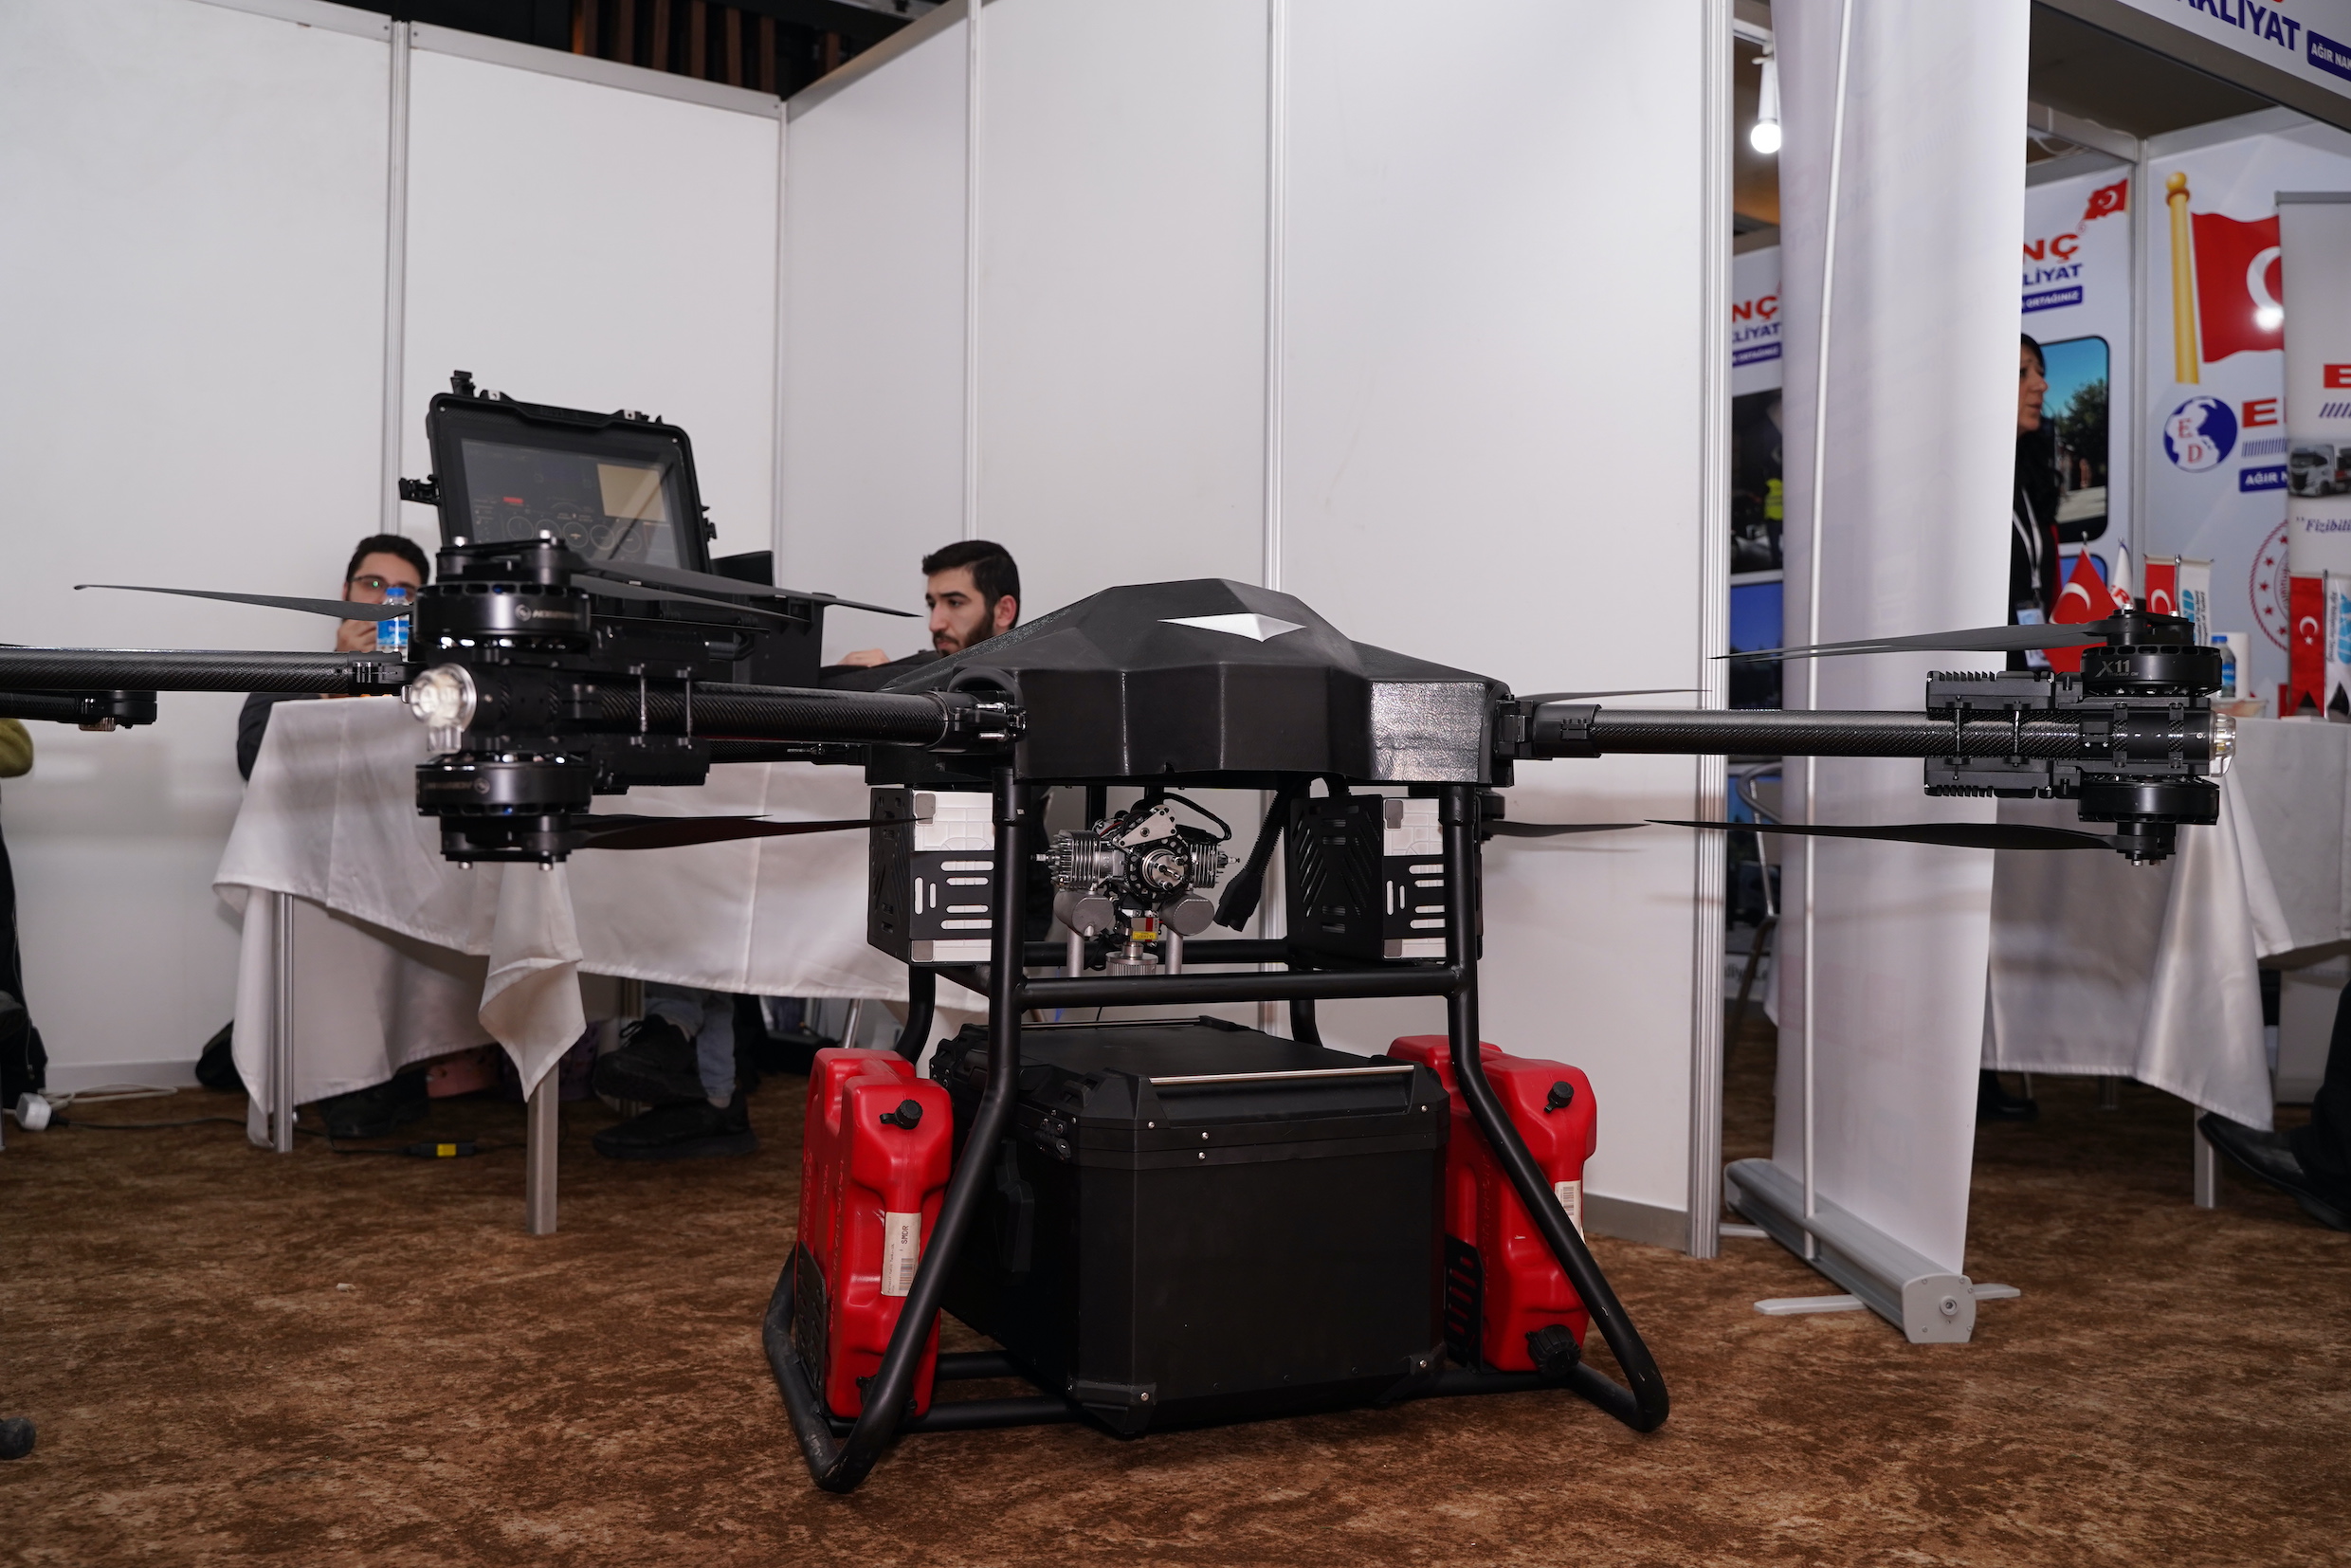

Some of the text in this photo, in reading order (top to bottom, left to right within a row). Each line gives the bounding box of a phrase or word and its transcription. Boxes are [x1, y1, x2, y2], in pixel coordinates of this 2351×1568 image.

[2310, 42, 2334, 64] AĞIR
[1732, 296, 1778, 322] NÇ
[2178, 418, 2193, 438] E
[2188, 444, 2203, 464] D
[2245, 470, 2278, 486] AĞIR
[2095, 659, 2130, 678] X11
